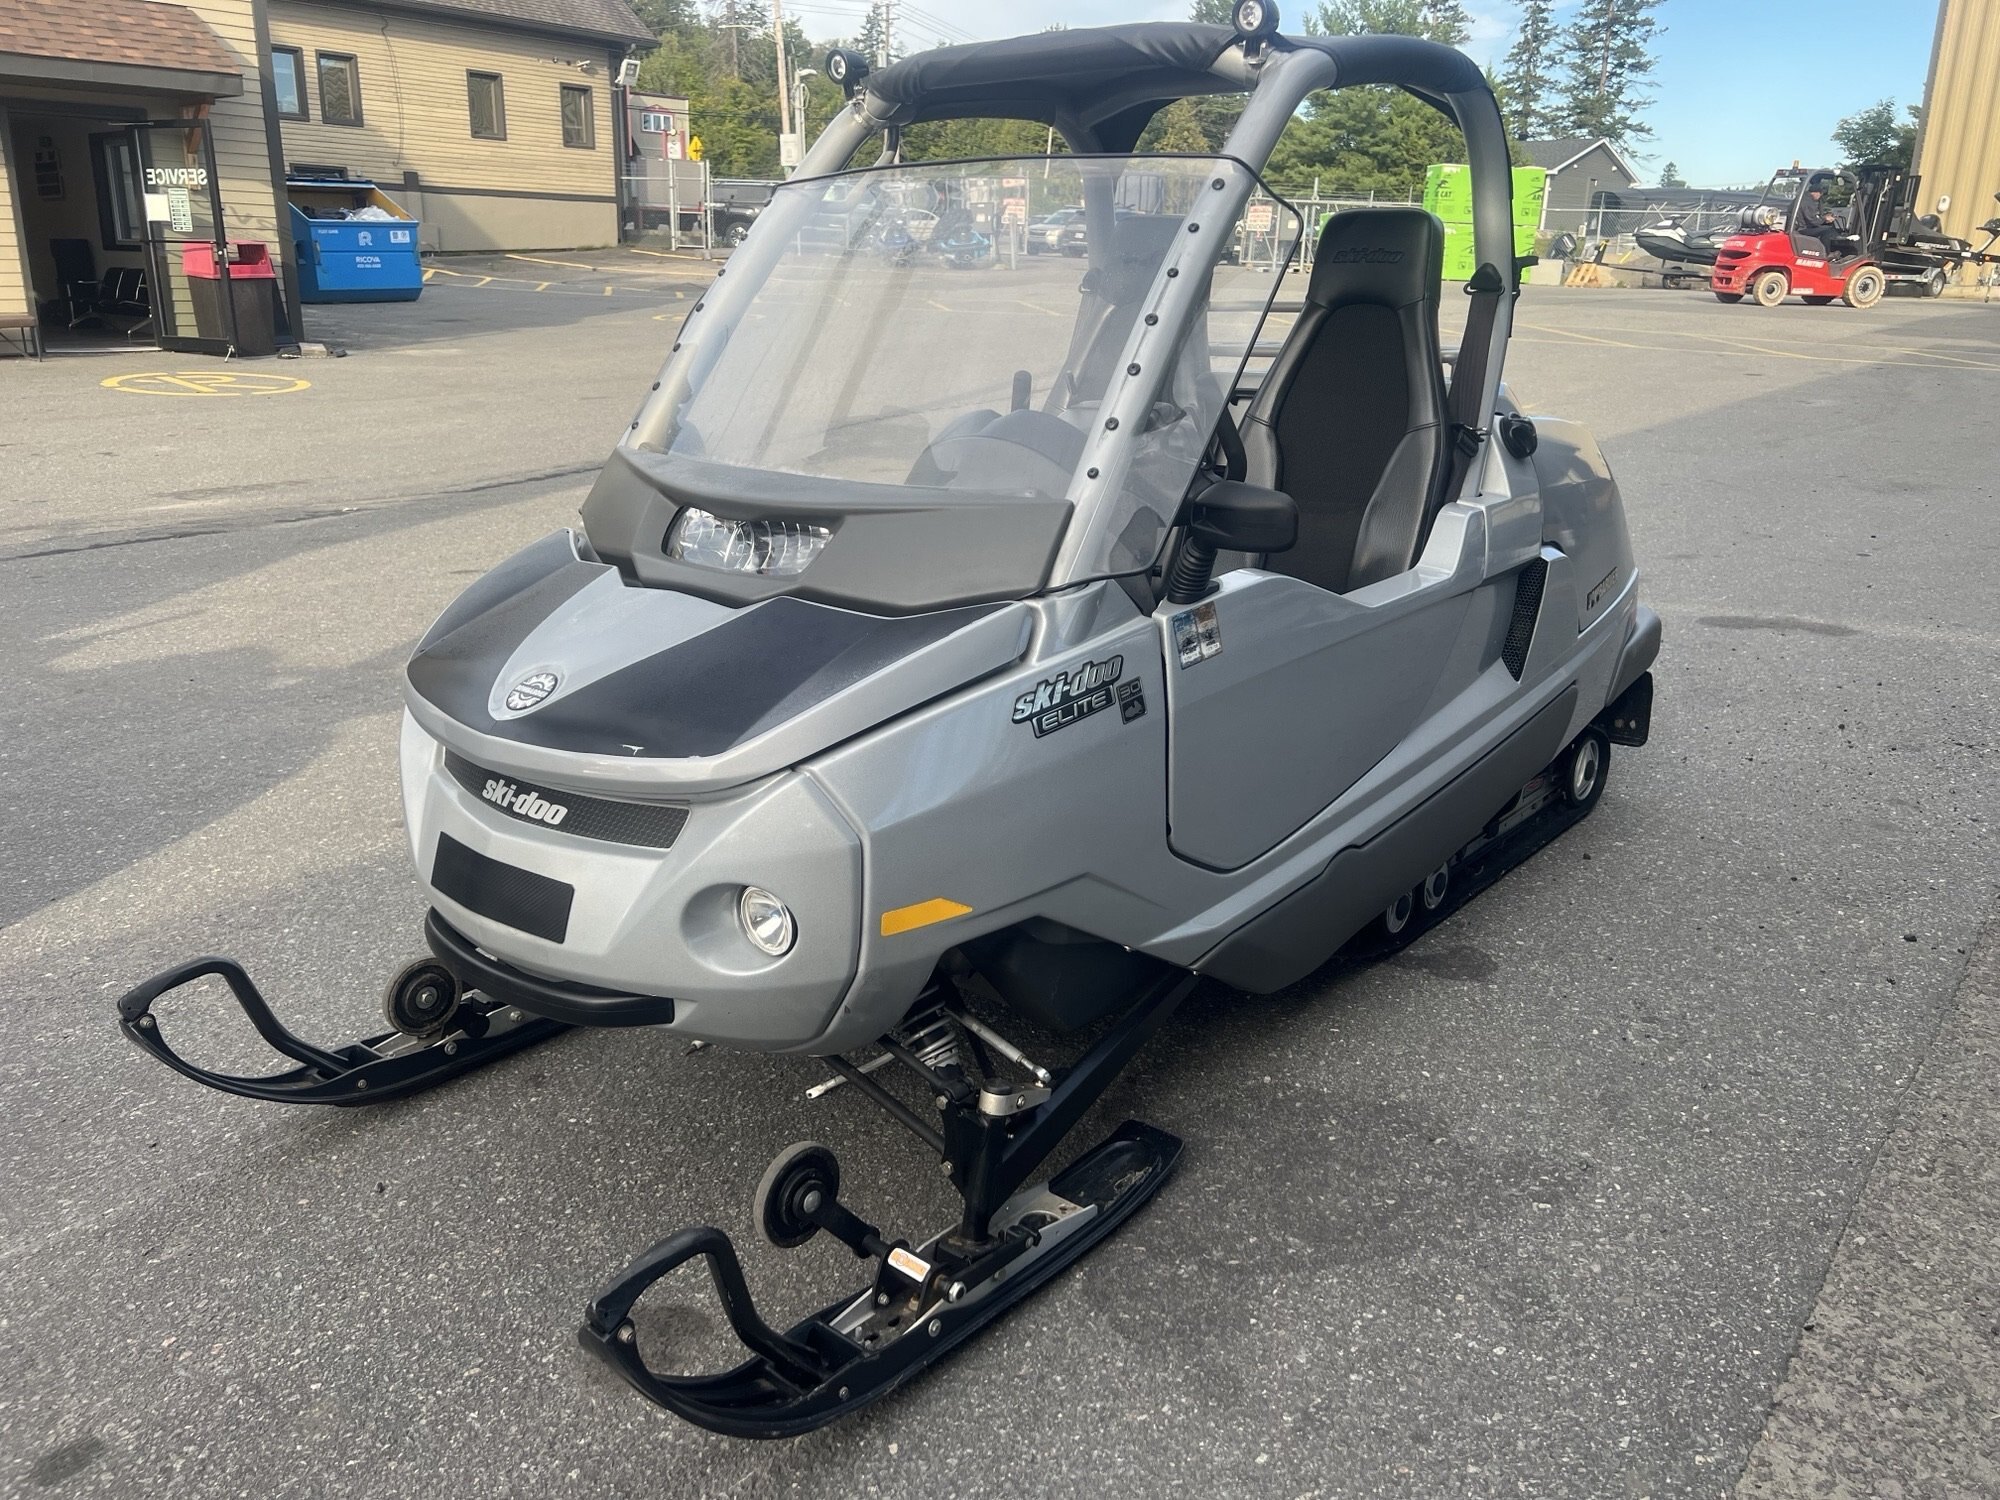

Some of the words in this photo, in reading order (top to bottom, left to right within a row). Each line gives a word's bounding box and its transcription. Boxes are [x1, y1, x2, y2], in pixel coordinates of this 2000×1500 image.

[355, 256, 381, 264] RICOVA
[1012, 655, 1123, 724] ski-doo
[1042, 690, 1107, 731] ELITE
[482, 779, 568, 825] ski-doo
